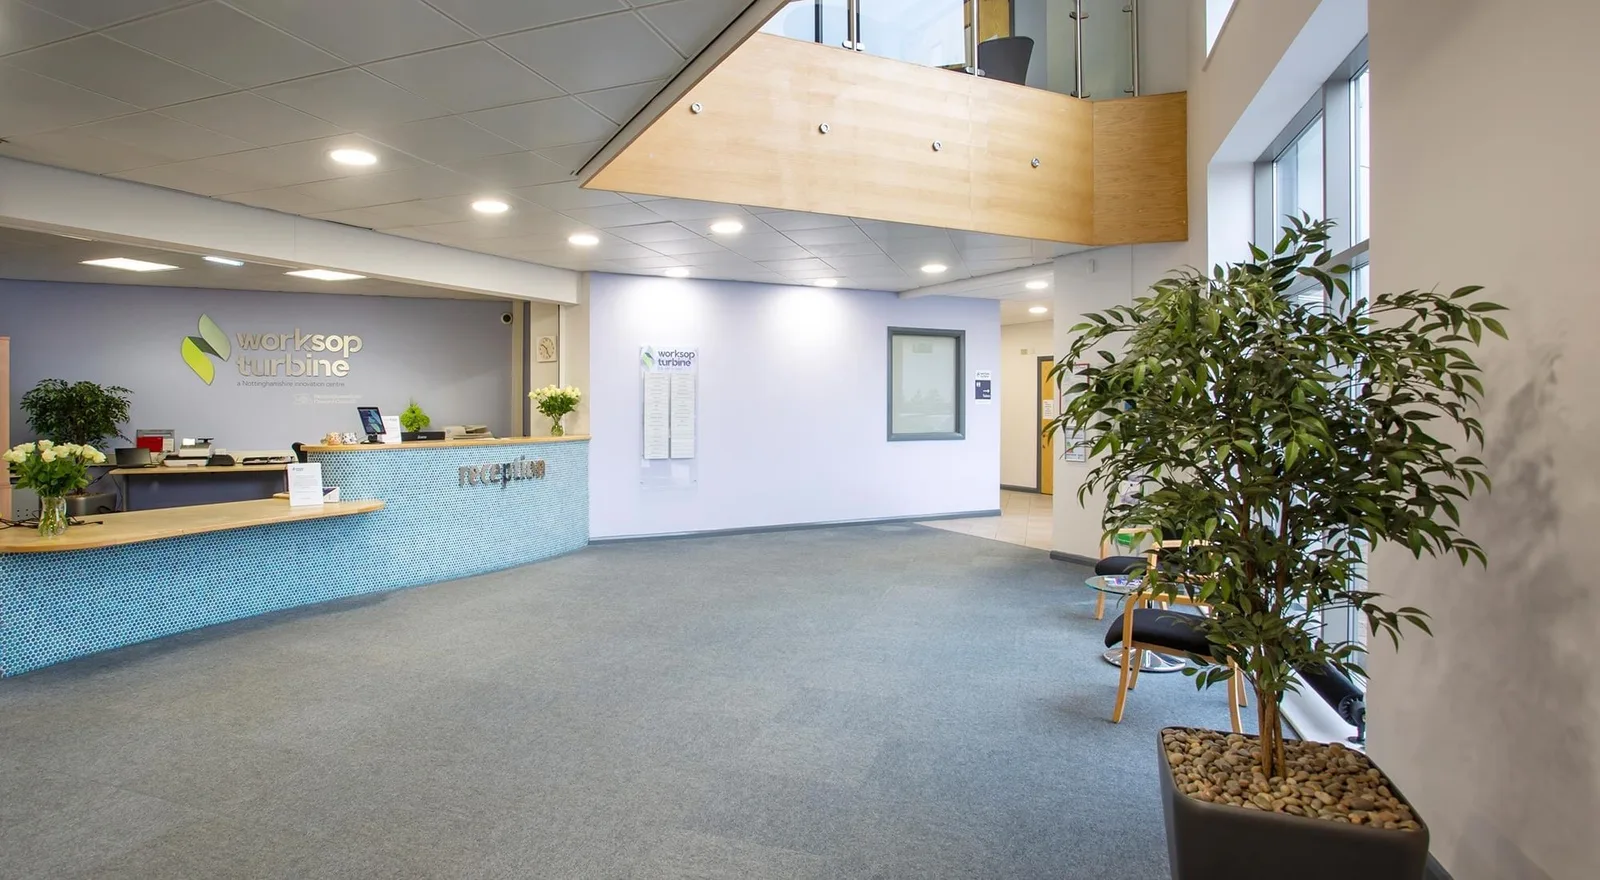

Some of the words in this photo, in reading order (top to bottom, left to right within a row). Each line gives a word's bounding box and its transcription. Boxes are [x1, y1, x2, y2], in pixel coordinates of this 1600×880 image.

[236, 328, 363, 357] worksop
[658, 349, 696, 360] worksop
[236, 352, 350, 377] turbine
[658, 358, 692, 367] turbine
[458, 454, 546, 489] reception
